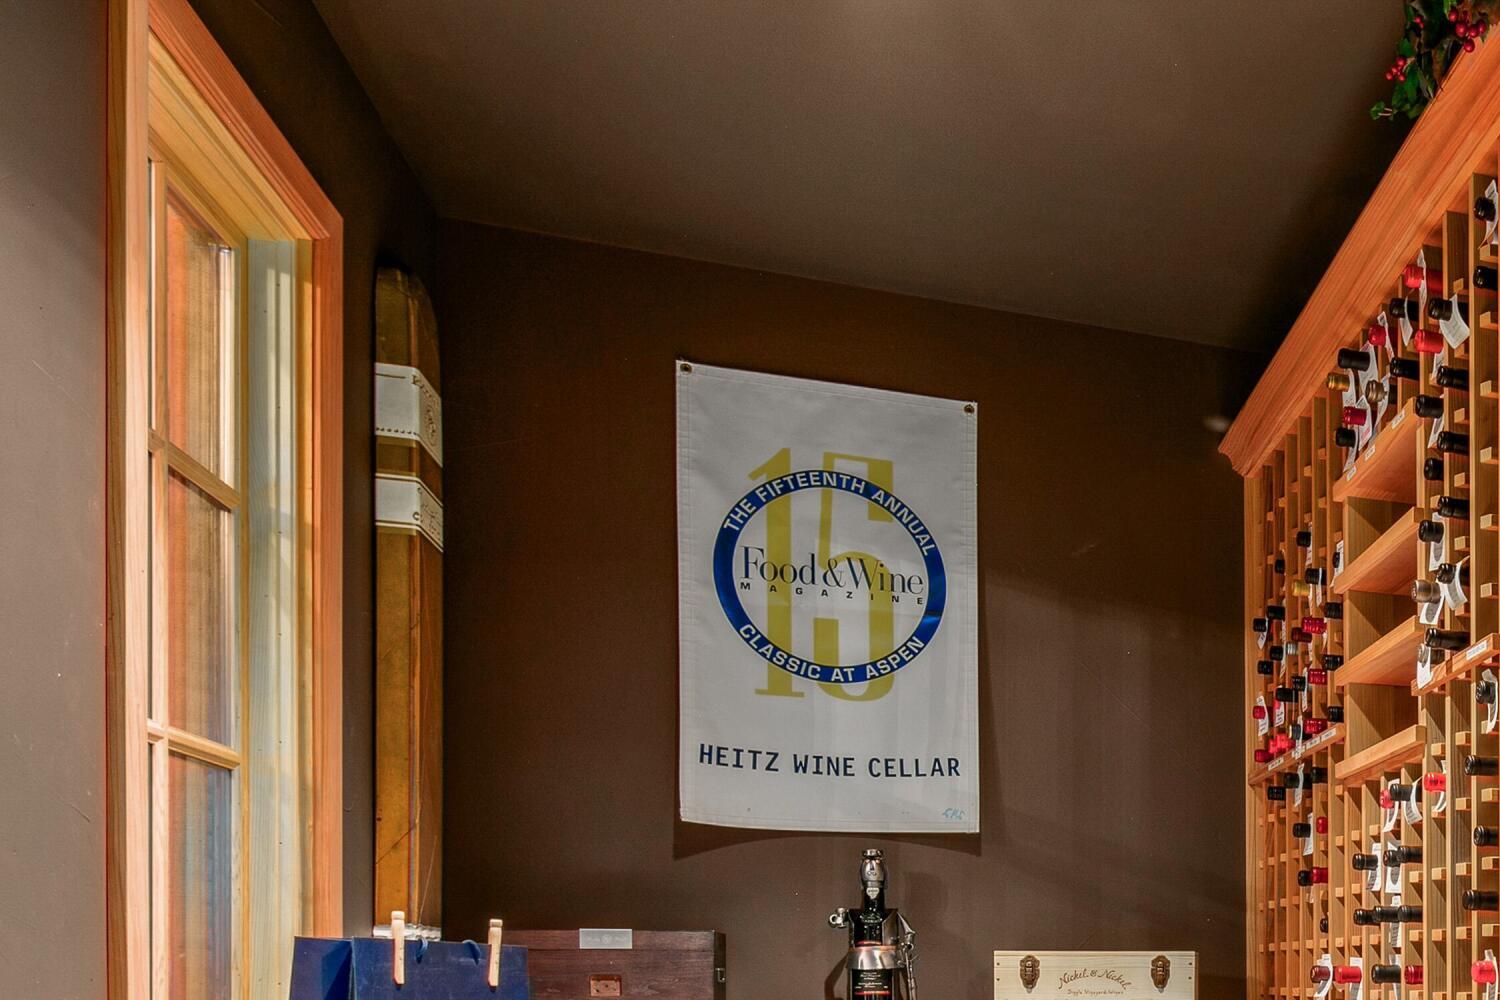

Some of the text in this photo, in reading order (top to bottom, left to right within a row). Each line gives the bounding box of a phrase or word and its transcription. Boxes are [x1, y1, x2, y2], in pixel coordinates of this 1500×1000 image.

[723, 470, 936, 557] THE FIFTEENTH ANNUAL
[740, 581, 924, 606] MAGAZINE
[748, 447, 895, 703] 15
[739, 623, 925, 683] CLASSIC AT ASPEN
[699, 742, 962, 778] HEITZ WINE CELLAR
